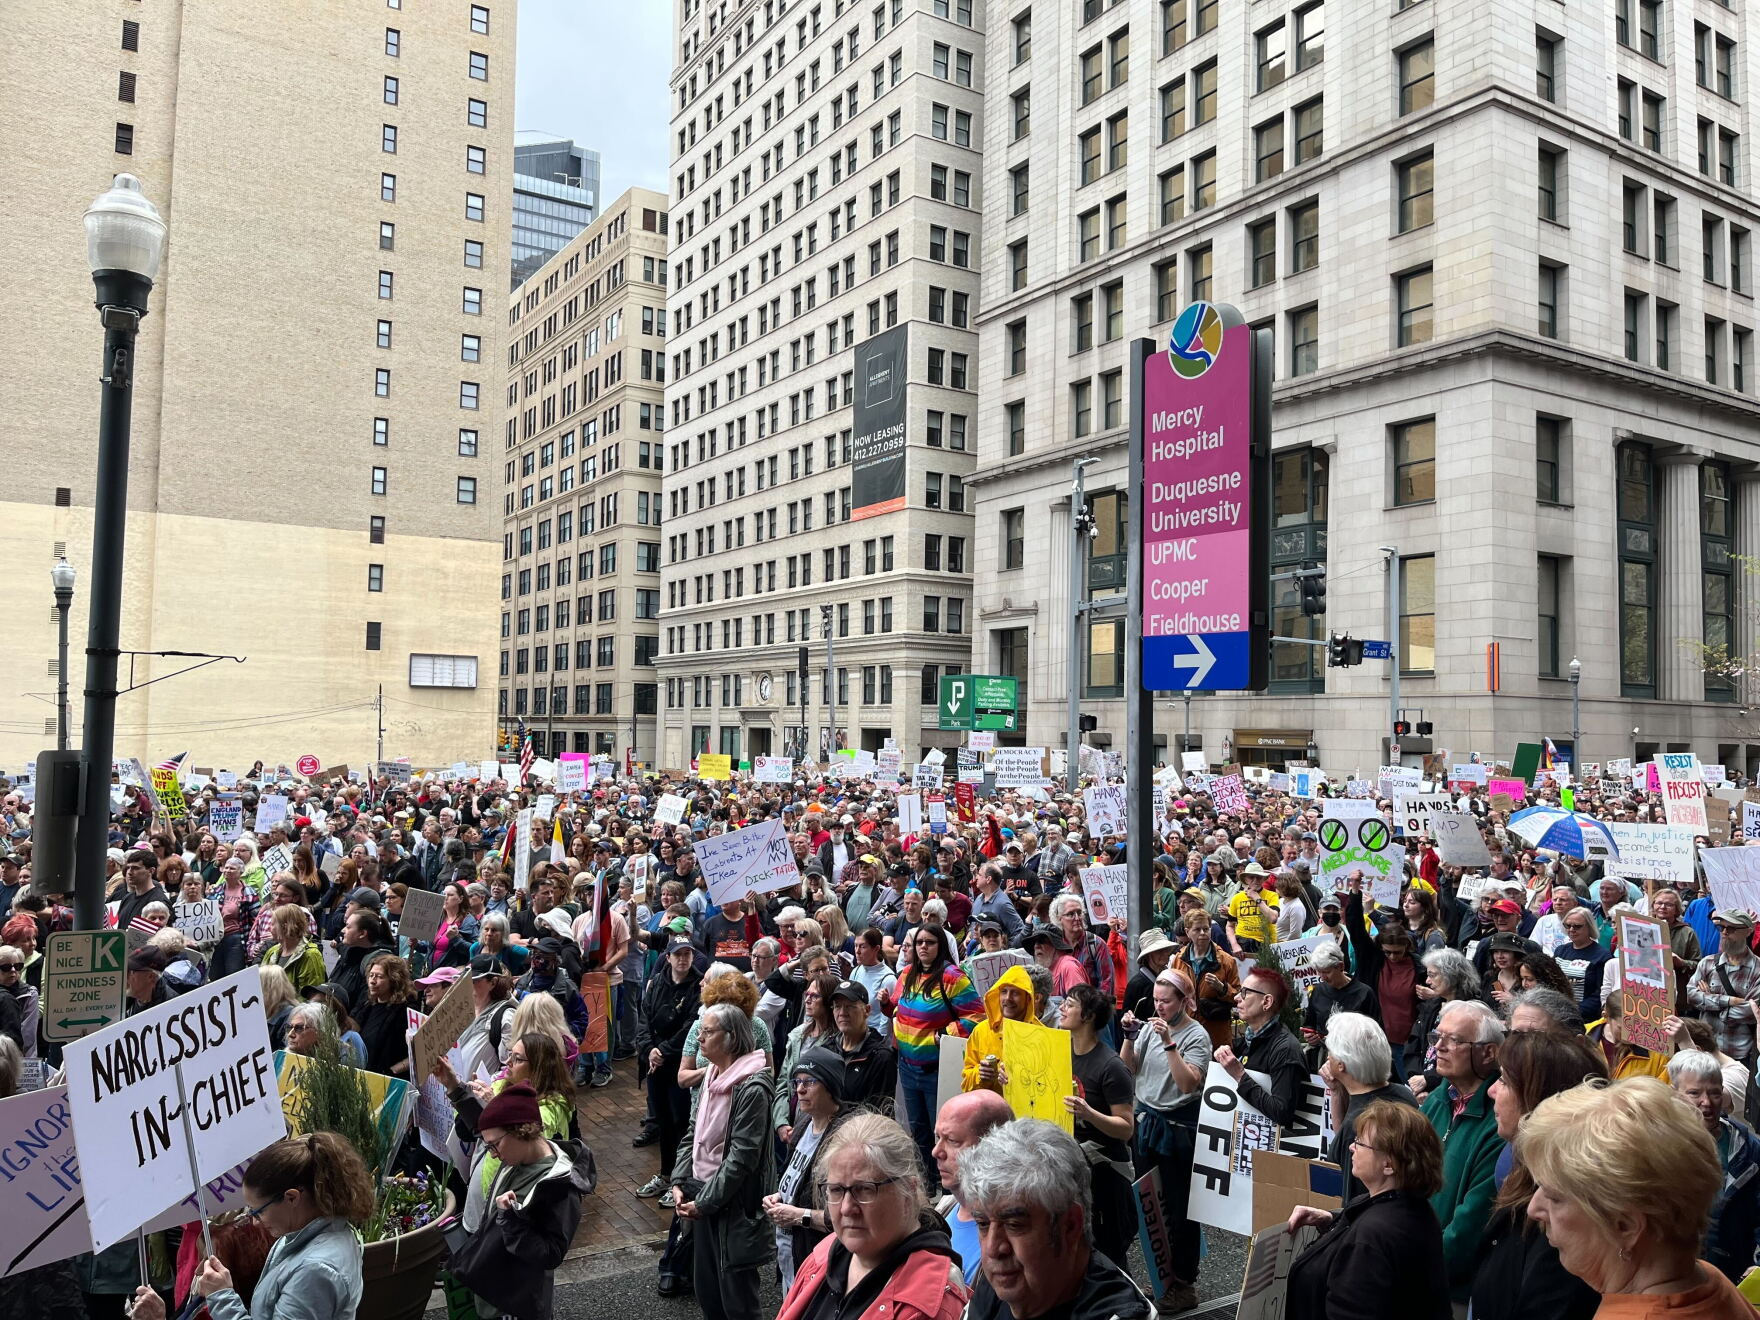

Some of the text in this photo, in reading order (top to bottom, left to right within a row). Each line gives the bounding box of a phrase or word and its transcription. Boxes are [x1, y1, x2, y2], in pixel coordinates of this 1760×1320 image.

[1152, 405, 1204, 434] Mercy
[854, 422, 904, 448] NOW LEASING
[1152, 426, 1224, 462] Hospital
[854, 436, 904, 461] 412.227.0959
[1152, 471, 1242, 505] Duquesne
[1151, 500, 1242, 533] University
[1151, 538, 1198, 566] UPMC
[1151, 577, 1208, 604] Cooper
[1150, 610, 1241, 636] Fieldhouse
[1362, 648, 1378, 656] Grant
[1664, 755, 1693, 768] RESIST
[1093, 787, 1120, 799] HANDS
[1667, 782, 1701, 799] FASCIST
[767, 838, 786, 852] NOT
[768, 849, 787, 865] MY
[1618, 841, 1689, 855] ecomes Law
[1321, 847, 1392, 875] MEDICARE
[1609, 857, 1672, 867] esistance
[1114, 885, 1124, 894] OFF
[175, 900, 213, 918] ELON
[57, 942, 72, 952] BE
[94, 936, 119, 968] K
[56, 957, 83, 968] NICE
[57, 976, 116, 989] KINDNESS
[1622, 976, 1669, 1006] MAKE
[70, 991, 101, 1002] ZONE
[1624, 993, 1672, 1025] DOGE
[1623, 1016, 1669, 1043] GREAT
[0, 1092, 71, 1182] IGNOR
[1193, 1085, 1238, 1196] OFF
[180, 1158, 252, 1215] TRU
[1139, 1191, 1170, 1281] PROTECT
